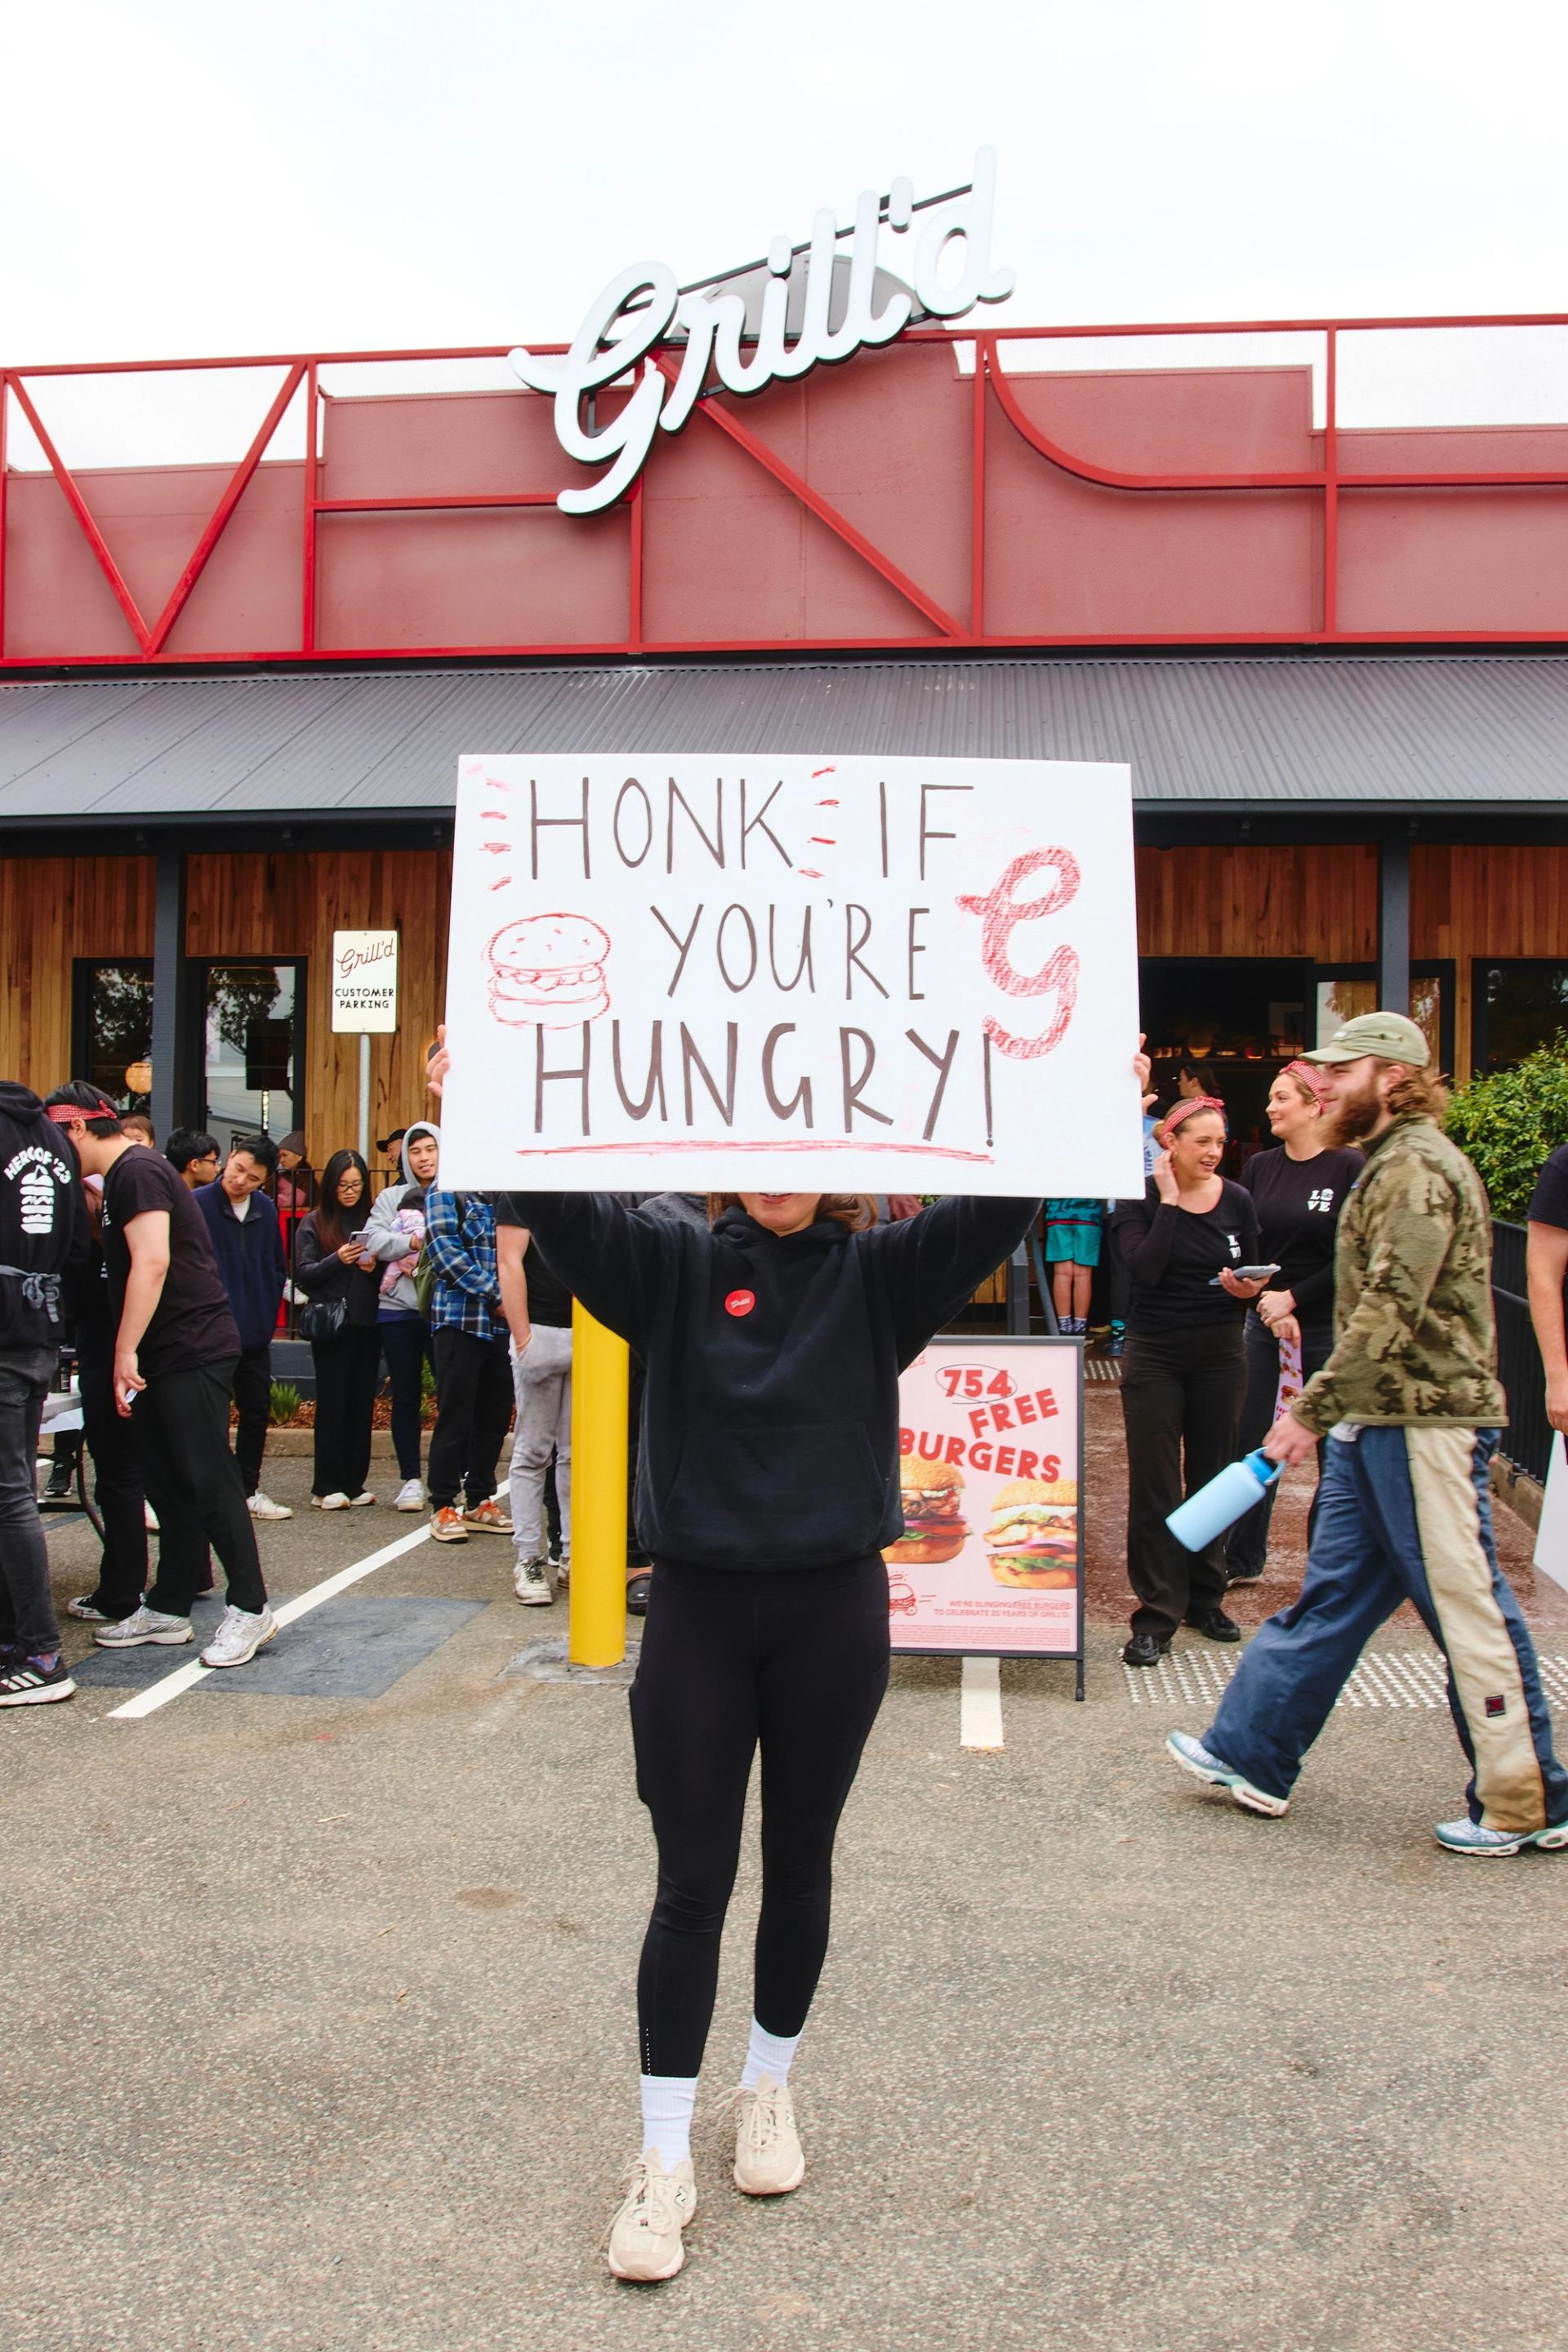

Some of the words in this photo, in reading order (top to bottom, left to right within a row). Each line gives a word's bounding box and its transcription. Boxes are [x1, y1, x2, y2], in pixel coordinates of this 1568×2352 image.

[508, 144, 1017, 516] Grill'd
[530, 777, 793, 880] HONK
[879, 782, 974, 880] IF
[336, 937, 394, 978] Grill'd
[650, 898, 930, 1000] YOU'RE
[335, 988, 394, 997] CUSTOMER
[340, 1000, 390, 1009] PARKING
[535, 1019, 995, 1147] HUNGRY!
[943, 1370, 1012, 1397] 754
[969, 1388, 1059, 1439] FREE
[899, 1427, 1062, 1484] BURGERS
